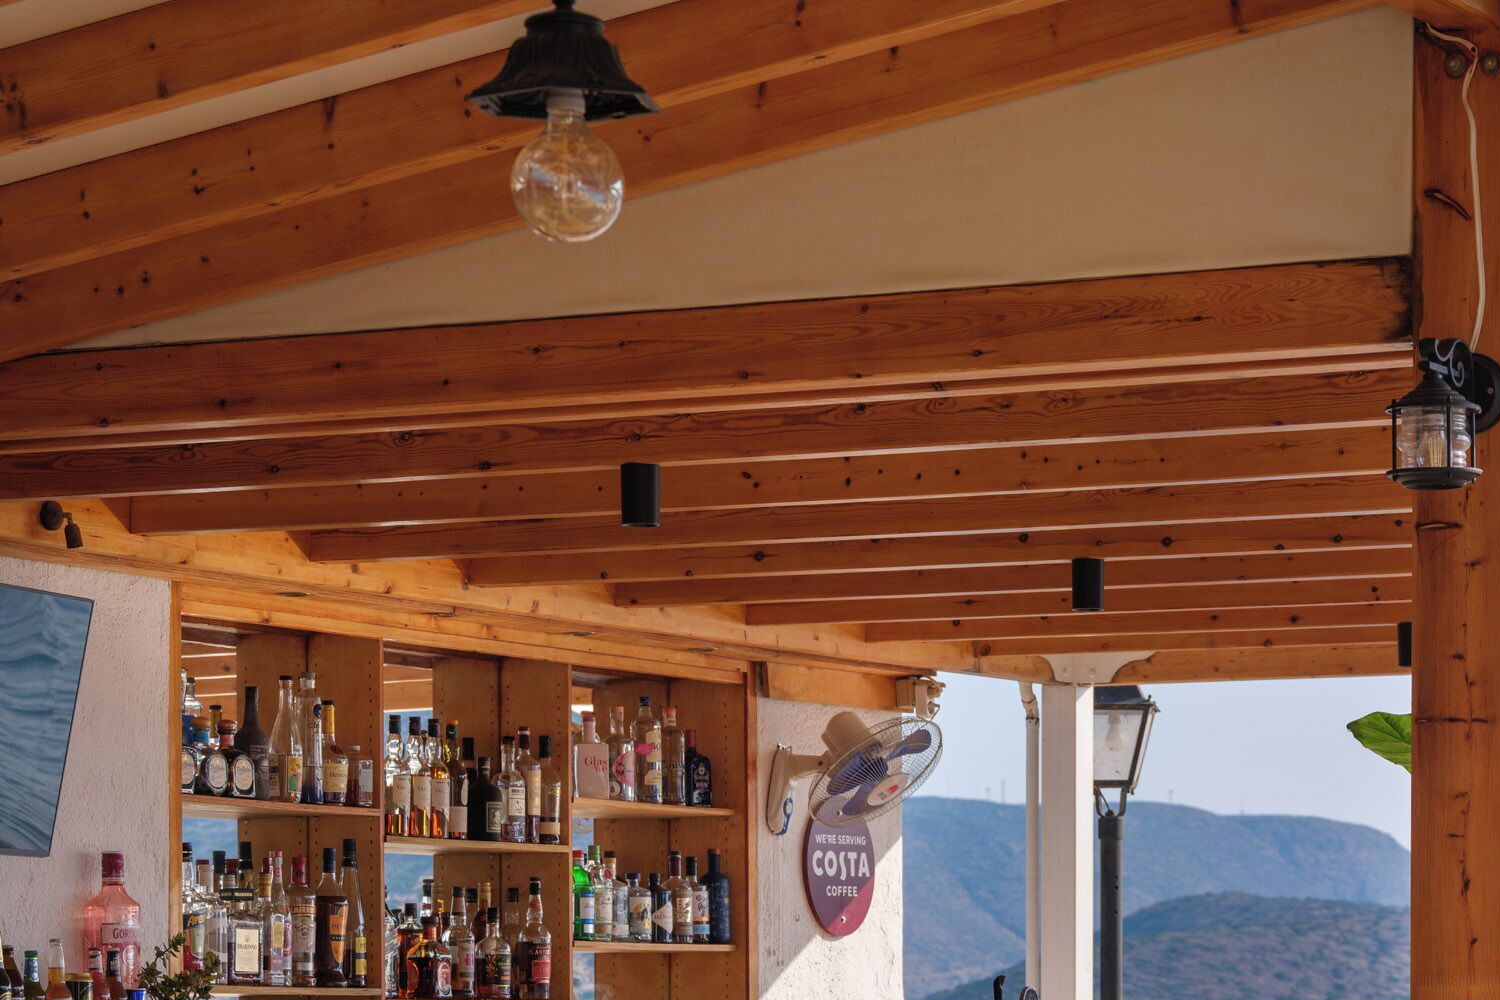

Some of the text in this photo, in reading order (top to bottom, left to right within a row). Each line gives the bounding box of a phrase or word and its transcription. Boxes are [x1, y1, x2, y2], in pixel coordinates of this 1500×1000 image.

[814, 833, 866, 846] WE'RE SERVING
[812, 849, 871, 881] COSTA
[825, 885, 858, 897] COFFEE
